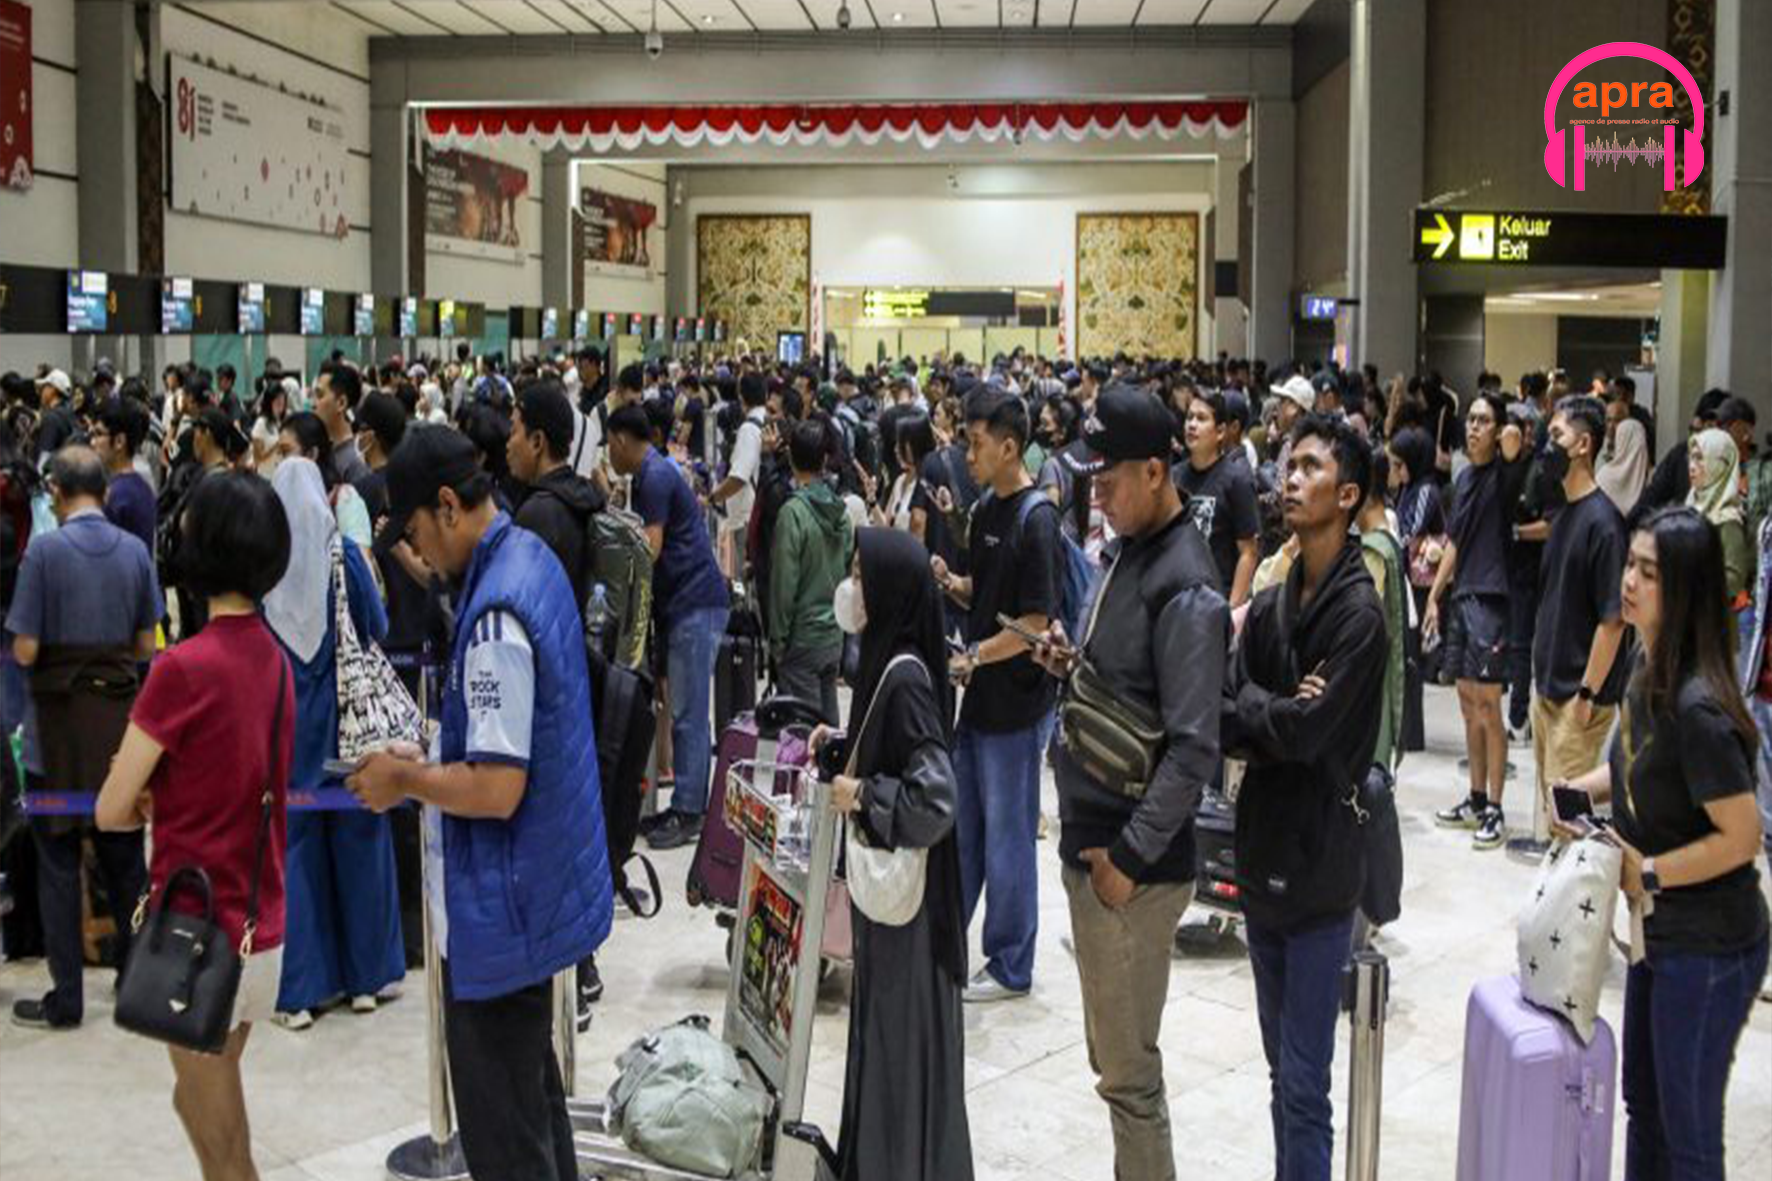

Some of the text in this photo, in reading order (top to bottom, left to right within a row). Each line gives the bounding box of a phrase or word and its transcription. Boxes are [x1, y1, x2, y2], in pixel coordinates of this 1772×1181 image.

[1500, 216, 1551, 236] Keluar
[1499, 239, 1528, 260] Exit
[470, 680, 500, 693] ROCK
